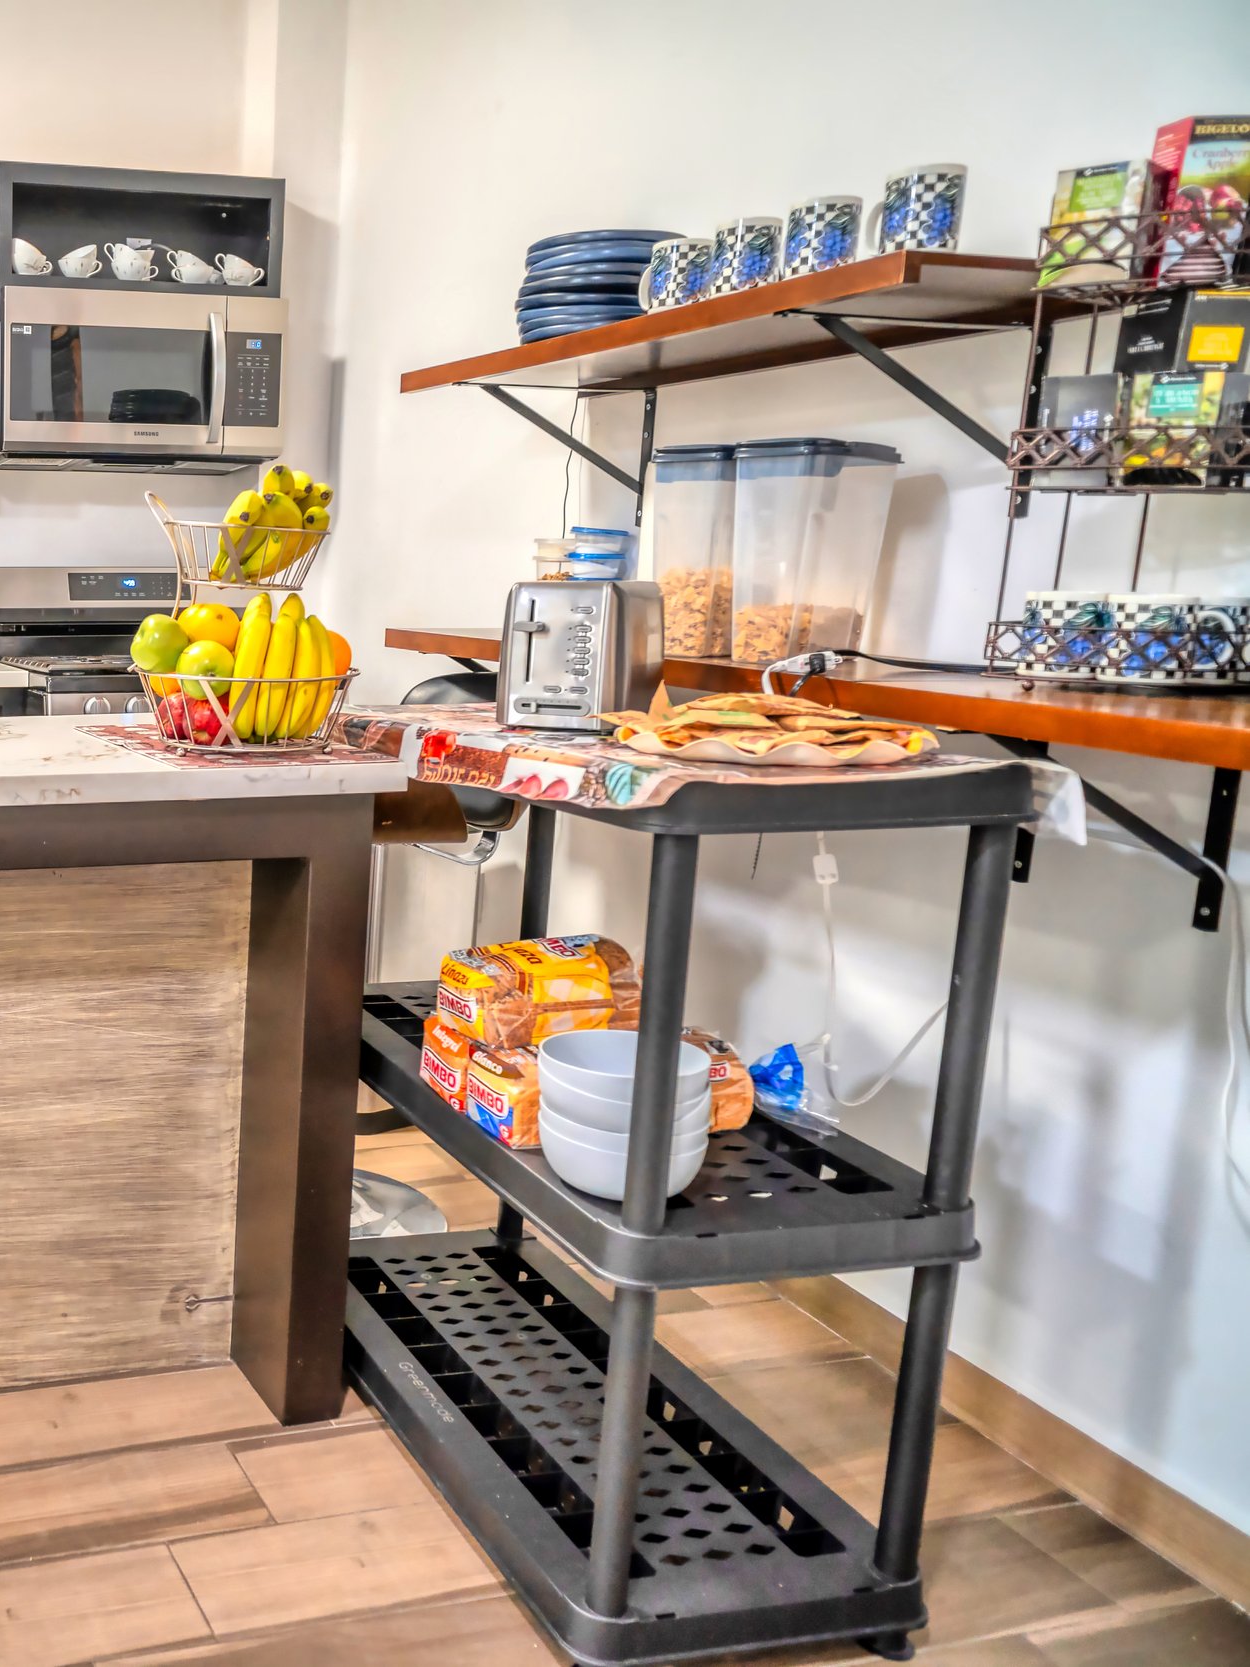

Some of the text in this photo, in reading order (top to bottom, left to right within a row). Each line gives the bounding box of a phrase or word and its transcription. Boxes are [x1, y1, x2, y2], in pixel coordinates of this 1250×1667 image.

[1195, 123, 1250, 135] BIGELO
[535, 938, 575, 957] MBO
[438, 989, 472, 1020] BIMBO
[423, 1051, 456, 1088] BIMBO
[472, 1051, 503, 1074] Blanco
[468, 1078, 505, 1114] BIMBO
